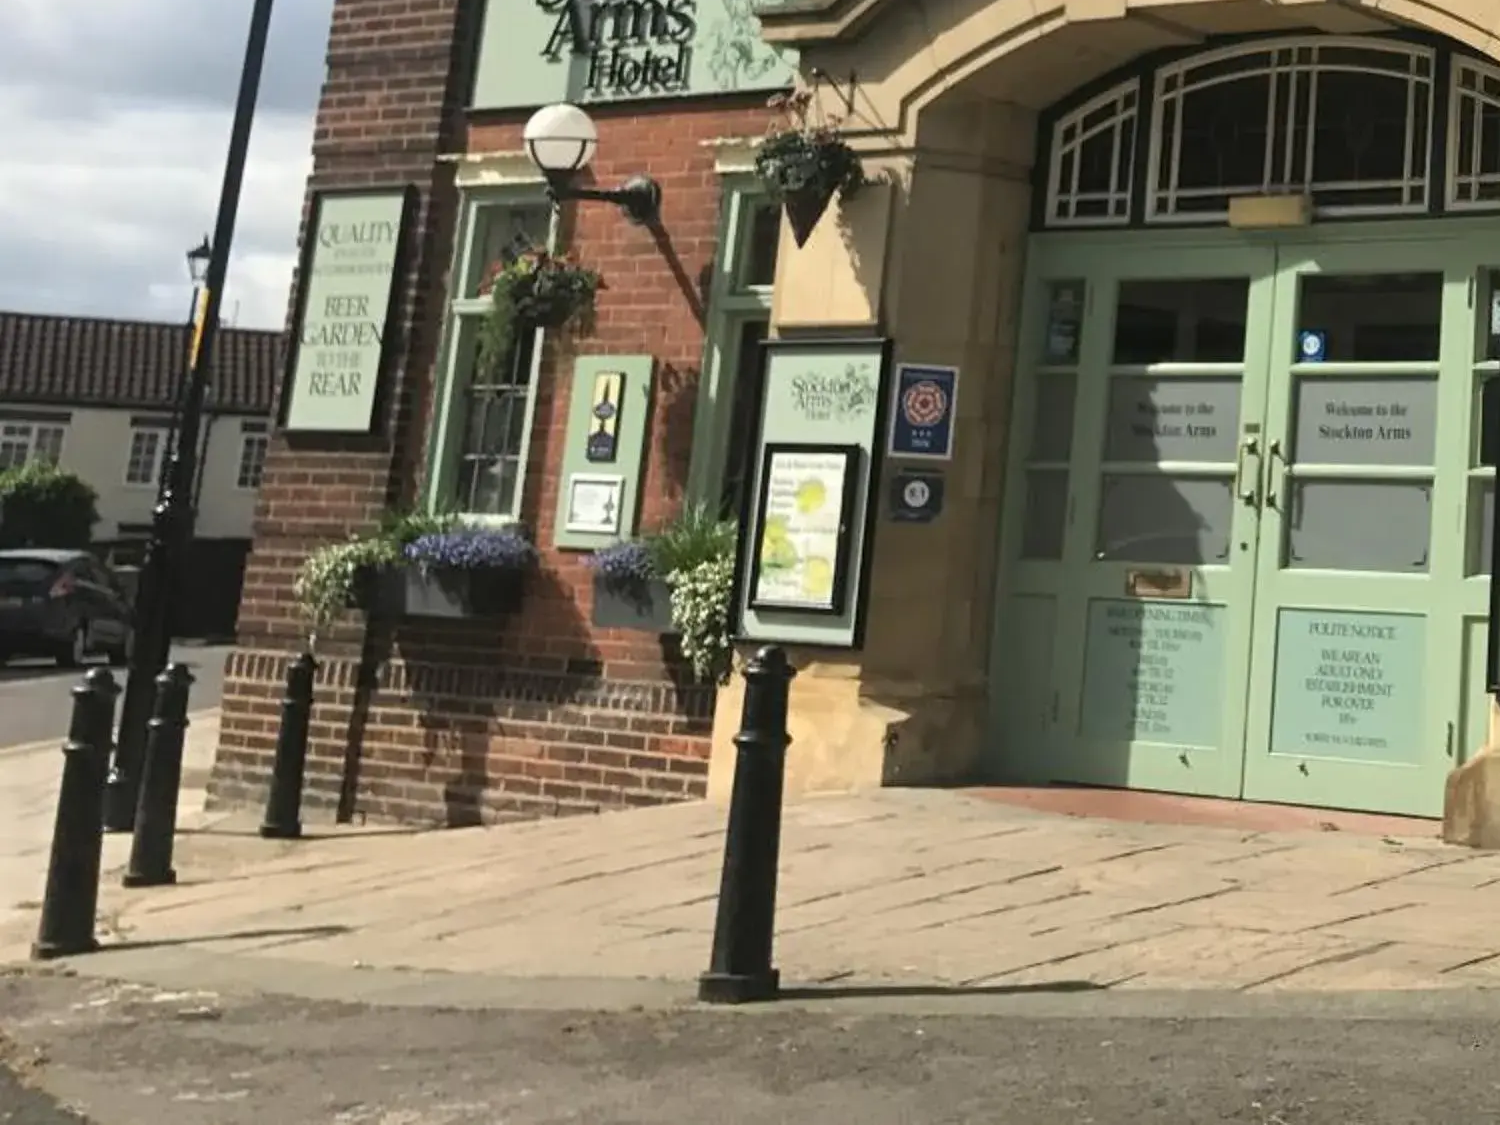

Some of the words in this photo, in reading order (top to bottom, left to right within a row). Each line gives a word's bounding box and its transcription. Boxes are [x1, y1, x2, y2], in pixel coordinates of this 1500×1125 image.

[586, 43, 693, 97] Hotel
[319, 221, 397, 248] QUALITY
[324, 295, 370, 318] BEER
[302, 322, 383, 347] GARDEN
[308, 372, 362, 397] REAR
[790, 377, 852, 397] Stockton
[794, 392, 833, 411] Arms
[1325, 400, 1373, 416] Welcome
[1376, 401, 1388, 416] to
[1390, 401, 1408, 416] the
[1318, 425, 1374, 440] Stockton
[1376, 425, 1412, 440] Arms
[1308, 622, 1347, 637] POLITE
[1349, 624, 1396, 640] NOTICE
[1316, 665, 1352, 678] ADULT
[1353, 666, 1384, 680] ONLY
[1305, 678, 1394, 697] ESTABLISHMENT
